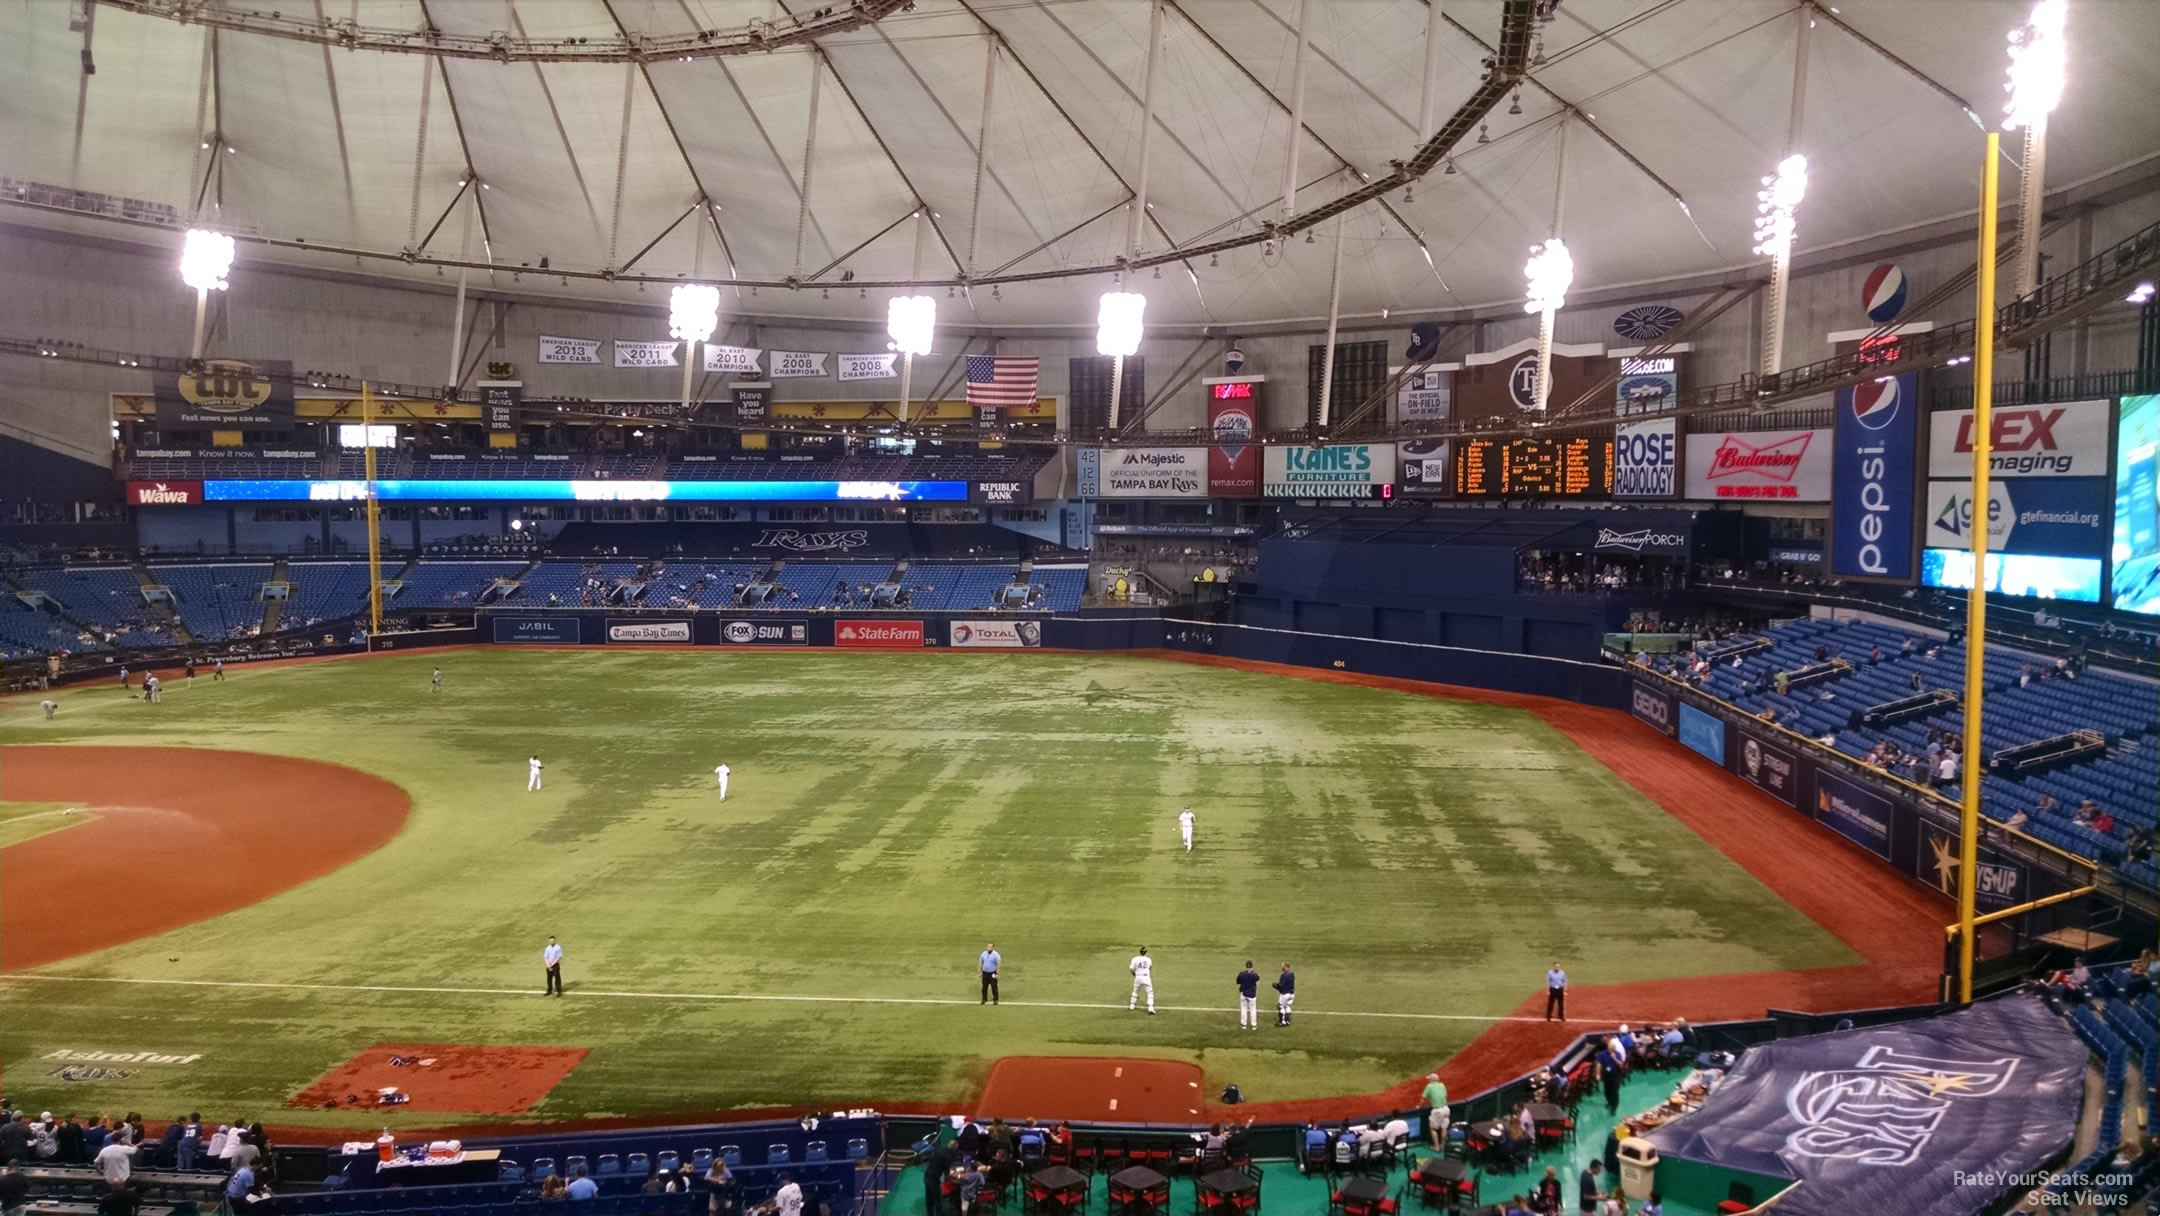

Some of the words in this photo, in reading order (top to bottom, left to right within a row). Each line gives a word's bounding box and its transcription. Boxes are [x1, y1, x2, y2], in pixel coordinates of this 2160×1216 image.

[554, 345, 585, 356] 2013
[630, 350, 660, 359] 2011
[546, 354, 566, 362] WILD
[621, 358, 642, 366] WILD
[716, 353, 746, 364] 2010
[707, 362, 754, 371] CHAMPIONS
[782, 359, 812, 368] 2008
[852, 361, 882, 371] 2008
[842, 370, 890, 378] CHAMPIONS
[739, 391, 762, 400] Have
[1215, 383, 1251, 399] RE/MAX
[742, 400, 760, 408] you
[1407, 399, 1440, 408] ON-FIELD
[492, 406, 510, 416] you
[738, 407, 764, 416] heard
[980, 406, 996, 414] you
[181, 414, 198, 422] Fast
[223, 415, 238, 424] you
[1954, 408, 2066, 454] DEX
[136, 450, 192, 458] tampabay.com
[200, 450, 226, 458] Know
[227, 450, 232, 458] it
[264, 450, 316, 458] tampabay.com
[1617, 433, 1674, 466] ROSE
[1081, 451, 1095, 463] 42
[1140, 454, 1186, 466] Majestic
[1286, 446, 1372, 471] KANE'S
[1715, 447, 1801, 468] Budweiser
[1988, 451, 2073, 474] maging
[1083, 467, 1093, 478] 12
[1289, 473, 1366, 481] FURNITURE
[1425, 470, 1440, 478] ERA
[1616, 466, 1673, 494] RADIOLOGY
[979, 482, 1020, 492] REPUBLIC
[1081, 483, 1095, 494] 66
[1110, 480, 1146, 490] TAMPA
[1149, 480, 1169, 490] BAY
[1170, 478, 1198, 493] RAYS
[139, 489, 190, 504] Wawa
[988, 491, 1012, 500] BANK
[1857, 447, 1890, 574] pepsi
[1960, 498, 2001, 528] ge
[2020, 510, 2099, 527] gtefinancial.org
[752, 528, 868, 551] RAYS
[1601, 532, 1646, 544] Budweiser
[1646, 535, 1684, 546] PORCH
[1780, 552, 1800, 561] GRAB
[1105, 566, 1134, 576] Ducky'
[354, 618, 366, 626] 162
[369, 618, 408, 626] LNDING
[518, 622, 555, 631] JABIL
[614, 628, 642, 639] Tampa
[642, 628, 659, 638] Bay
[660, 627, 686, 638] Times
[732, 625, 750, 634] FOX
[758, 627, 784, 639] SUN
[976, 629, 1016, 638] TOTAL
[381, 640, 394, 648] 315
[207, 655, 246, 663] Petersburg
[248, 652, 280, 660] Welcomes
[1634, 689, 1668, 724] GEICO
[1770, 771, 1784, 788] LIVE
[1976, 864, 1994, 892] YS
[1996, 868, 2016, 895] UP
[1138, 961, 1148, 969] 42
[40, 1049, 204, 1064] AstroTurf
[38, 1133, 46, 1143] 9
